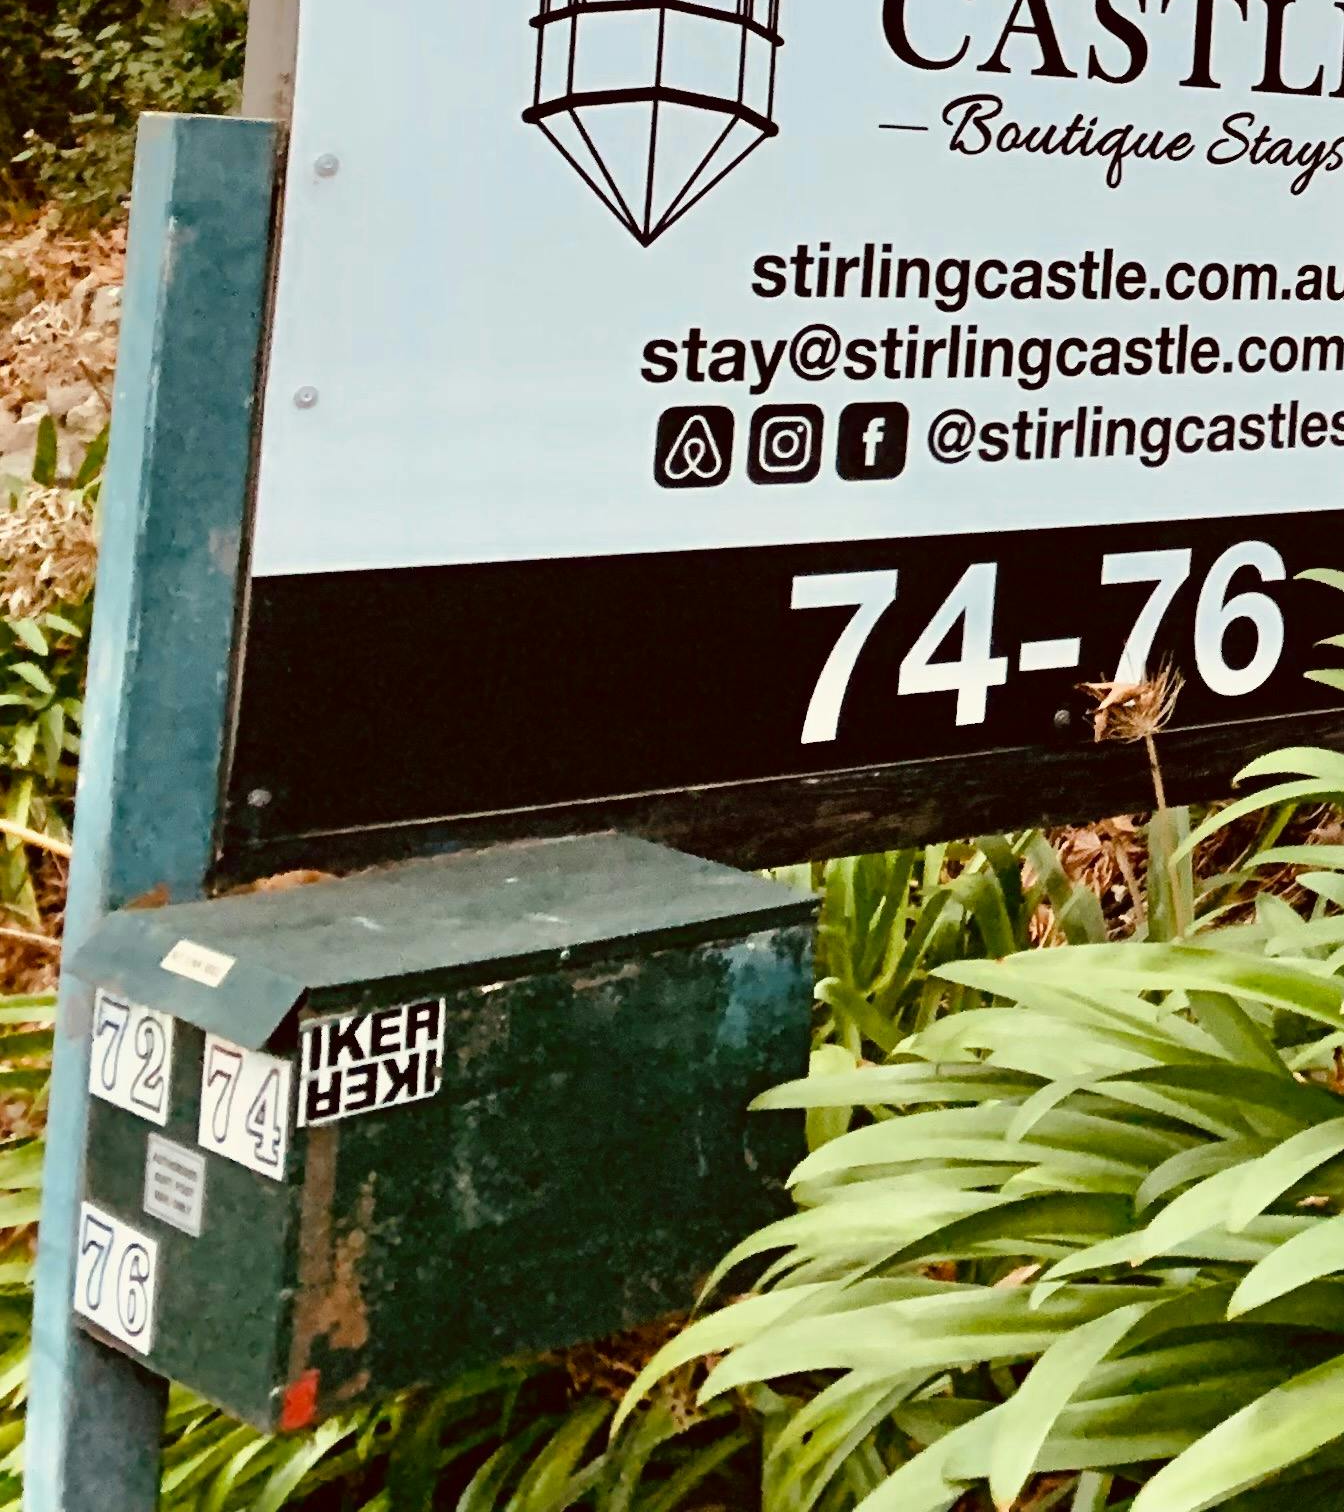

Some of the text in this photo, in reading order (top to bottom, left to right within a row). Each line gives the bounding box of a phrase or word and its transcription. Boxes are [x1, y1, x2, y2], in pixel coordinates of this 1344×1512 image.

[942, 93, 1196, 189] Boutique
[790, 540, 1287, 745] 74-76
[96, 996, 167, 1115] 72
[206, 1042, 281, 1167] 74
[80, 1213, 151, 1336] 76
